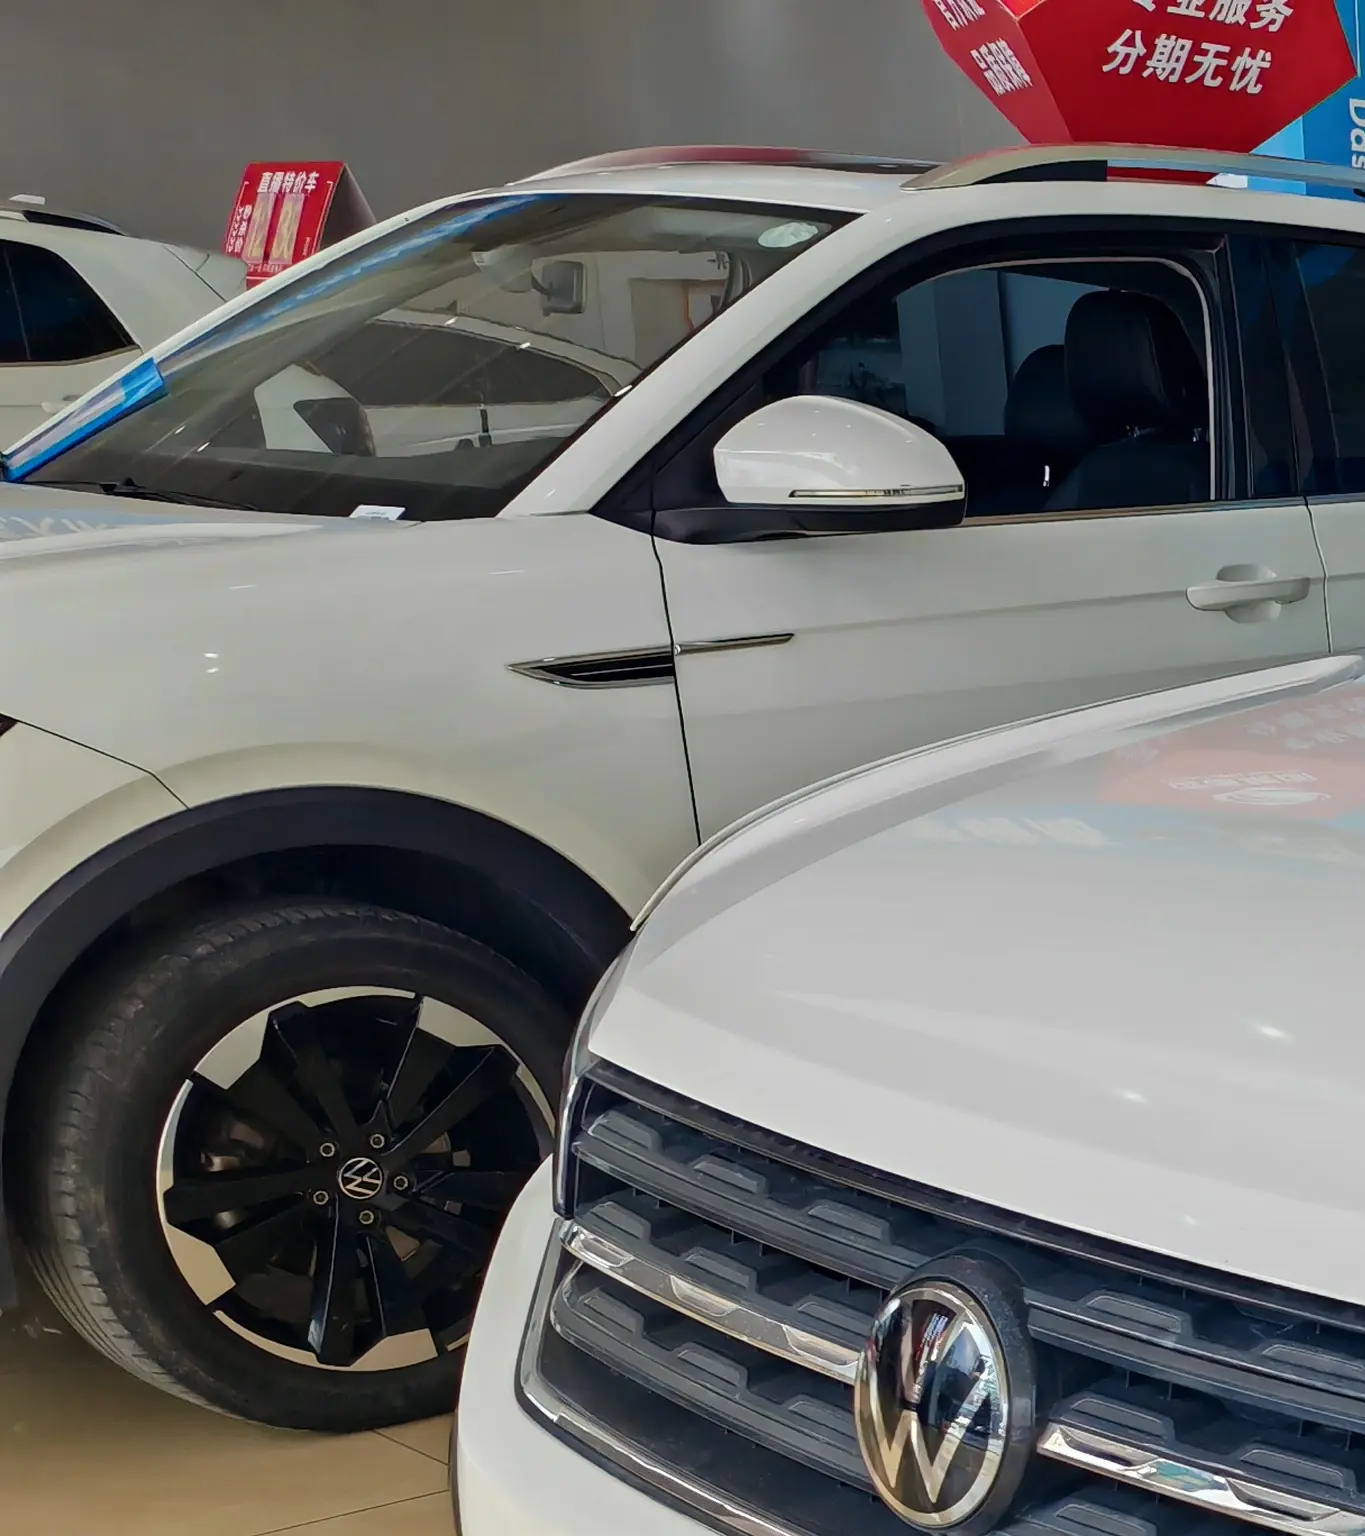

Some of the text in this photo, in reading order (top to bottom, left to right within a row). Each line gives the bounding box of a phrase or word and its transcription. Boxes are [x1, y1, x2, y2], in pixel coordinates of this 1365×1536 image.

[1101, 27, 1273, 95] 分期无忧
[257, 171, 320, 193] 直播特价车
